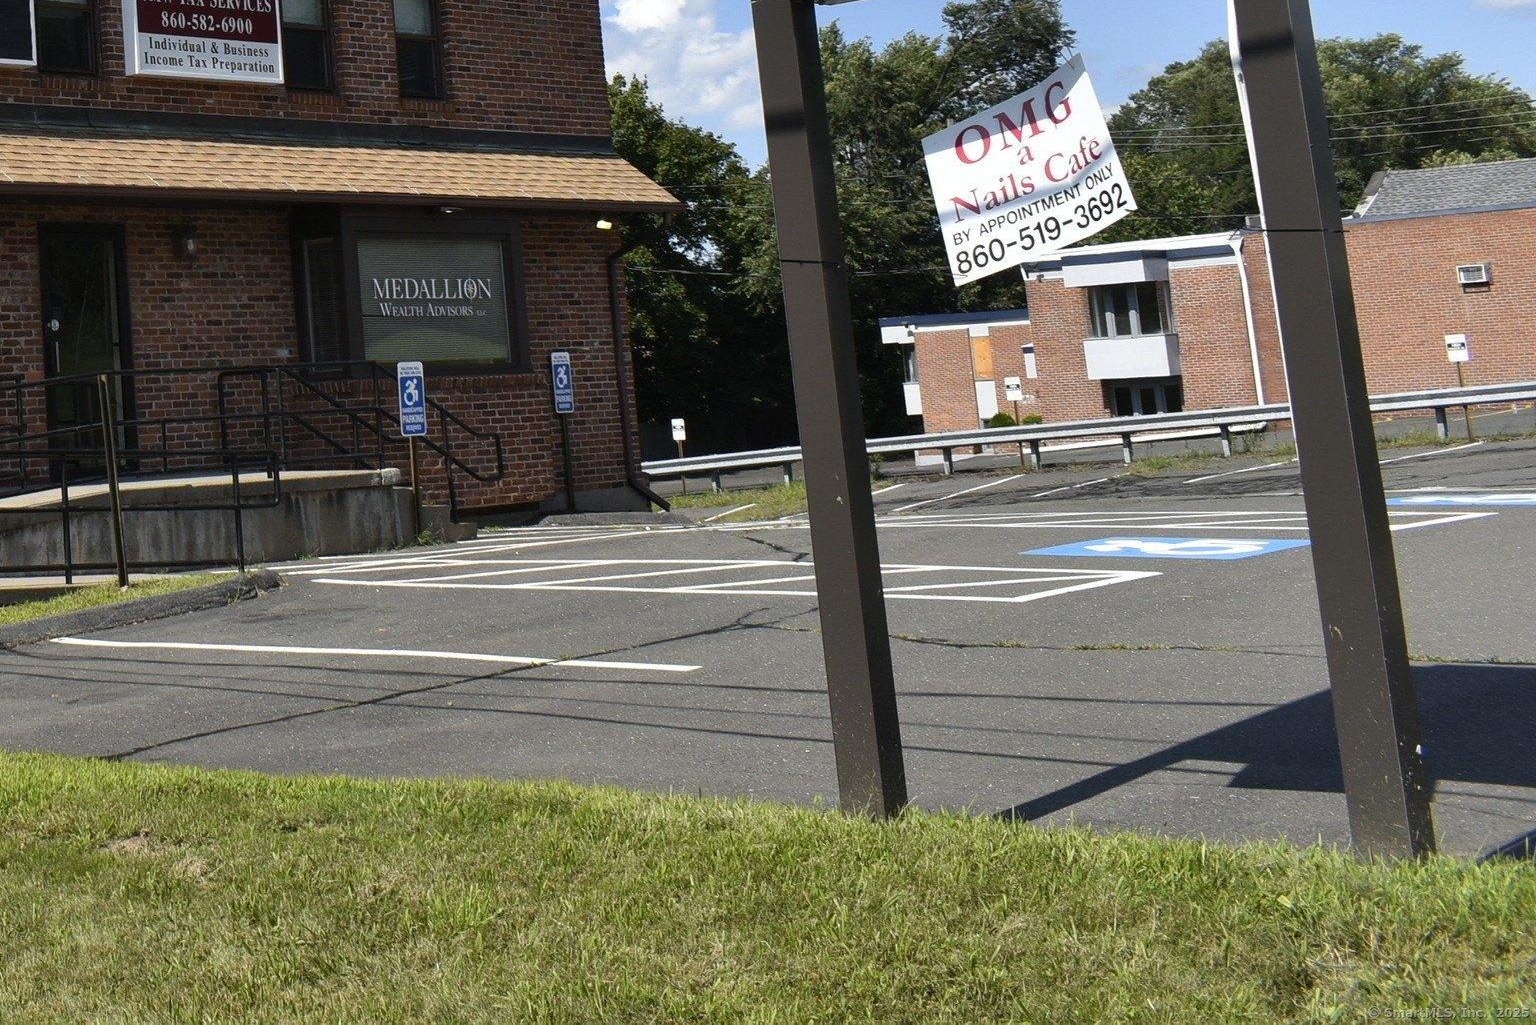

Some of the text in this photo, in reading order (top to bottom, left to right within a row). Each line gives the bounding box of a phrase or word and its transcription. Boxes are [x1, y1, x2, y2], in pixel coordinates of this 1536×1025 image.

[161, 11, 253, 35] 860-582-6900
[148, 36, 269, 58] Individual & Business
[144, 52, 275, 74] Income Tax Preparation
[954, 80, 1072, 165] OMG
[1017, 145, 1035, 166] a
[949, 173, 1036, 224] Nails
[952, 162, 1114, 246] BY APPOINTMENT ONLY
[955, 182, 1127, 275] 860-519-3692
[373, 277, 492, 300] MEDALLION
